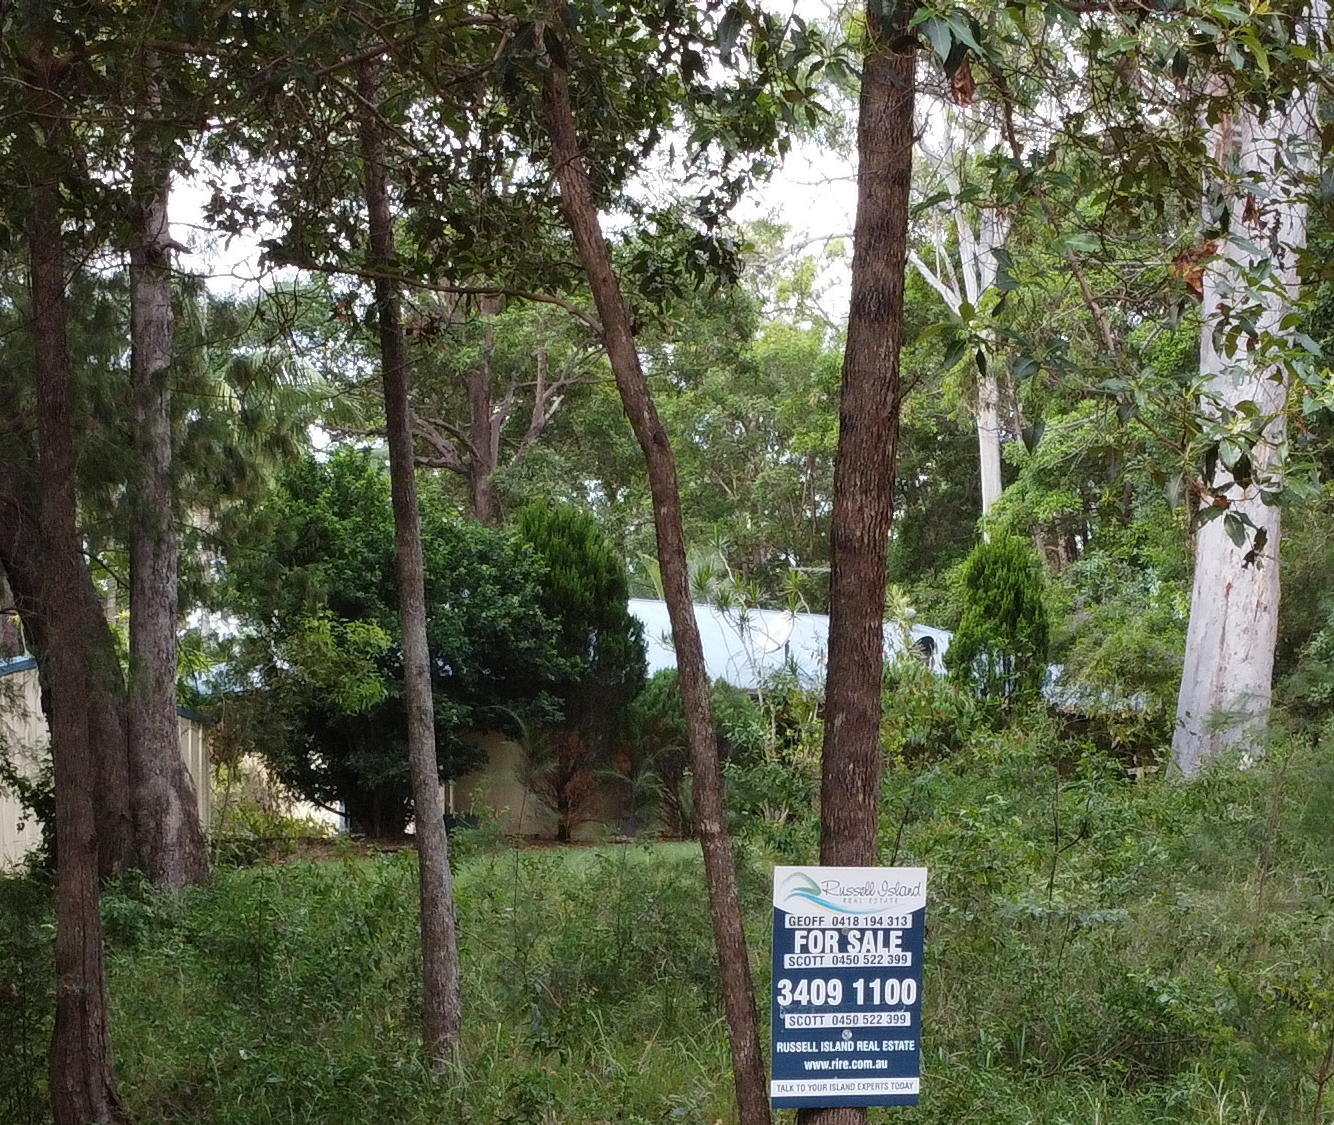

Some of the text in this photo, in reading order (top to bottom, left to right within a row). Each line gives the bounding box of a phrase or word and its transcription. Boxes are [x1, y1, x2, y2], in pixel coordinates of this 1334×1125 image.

[821, 880, 921, 897] Russell Island
[788, 916, 908, 927] GEOFF 0418 194 313
[795, 930, 903, 954] FOR SALE
[788, 954, 908, 966] SCOTT 0450 522 399
[777, 978, 917, 1006] 3409 1100
[789, 1014, 906, 1026] SCOTT 0450 522 399
[777, 1040, 915, 1053] RUSSELL ISLAND REAL ESTATE
[804, 1058, 888, 1070] www.rire.com.au
[776, 1084, 795, 1092] TALK
[796, 1084, 805, 1092] TO
[807, 1084, 828, 1092] YOUR
[829, 1083, 855, 1091] ISLAND
[890, 1082, 914, 1090] TODAY
